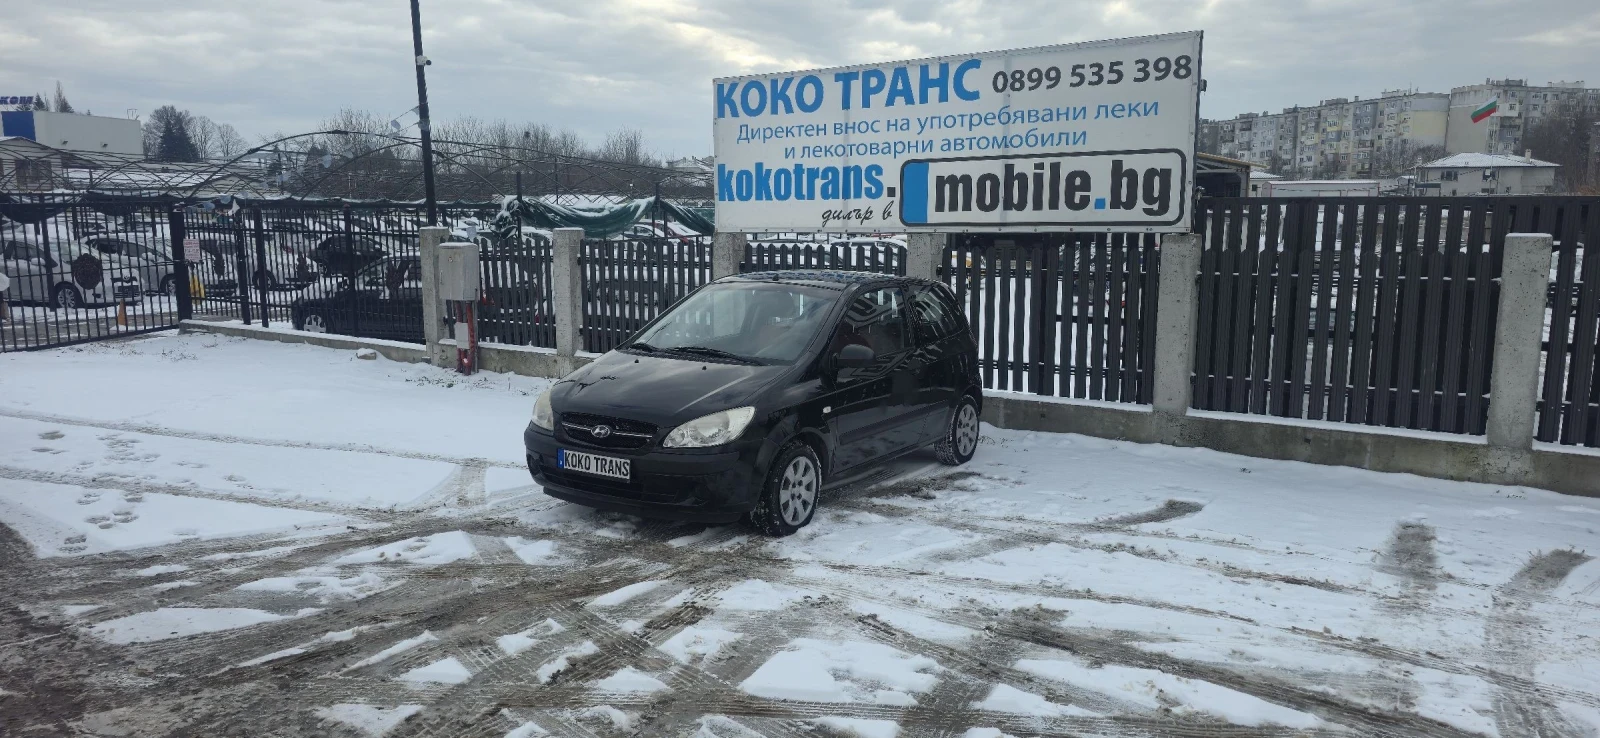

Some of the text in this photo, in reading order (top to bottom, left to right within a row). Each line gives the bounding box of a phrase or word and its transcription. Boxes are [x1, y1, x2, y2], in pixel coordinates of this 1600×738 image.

[717, 58, 982, 118] КОКО ТРАНС
[992, 55, 1192, 93] 0899 535 398
[737, 101, 1159, 144] Директен внос на употребявани леки
[784, 128, 1087, 159] и лекотоварни автомобили
[935, 160, 1172, 216] mobile.bg
[822, 200, 893, 227] дилър в
[564, 452, 629, 476] KOKO TRANS
